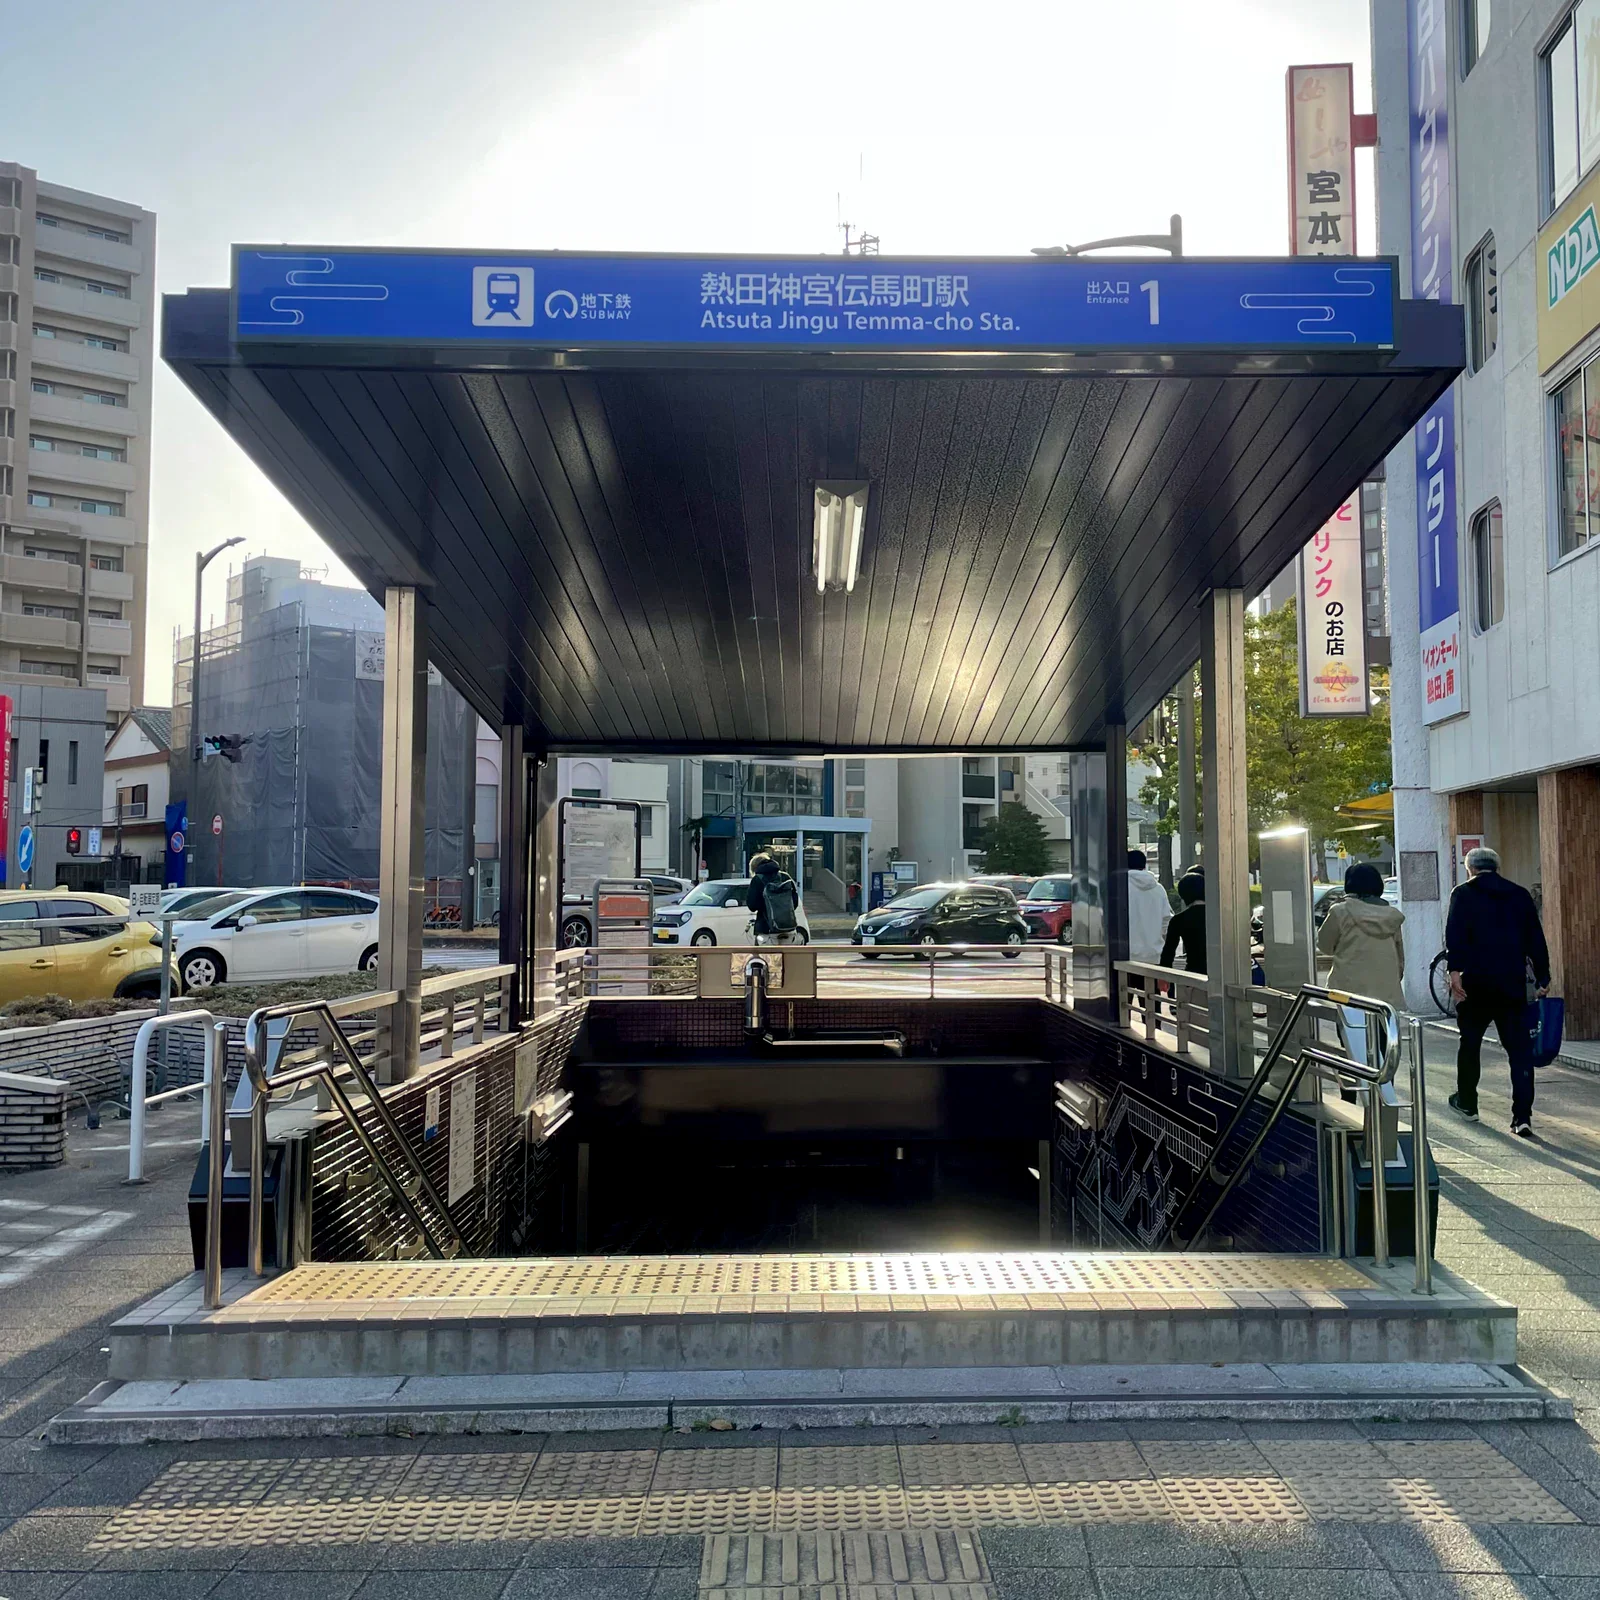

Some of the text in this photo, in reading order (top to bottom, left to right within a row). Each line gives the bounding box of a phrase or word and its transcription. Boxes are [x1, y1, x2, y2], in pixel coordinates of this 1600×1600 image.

[1306, 170, 1351, 256] 宮本
[1549, 205, 1600, 308] NDA
[580, 293, 632, 309] 地下鉄
[700, 271, 970, 308] 熱田神宮伝馬町駅
[1086, 295, 1130, 304] Entrance
[1086, 279, 1160, 326] 出入口 1
[580, 309, 632, 320] SUBWAY
[700, 310, 1021, 335] Atsuta Jingu Temma-cho Sta.
[1325, 601, 1345, 656] のお店
